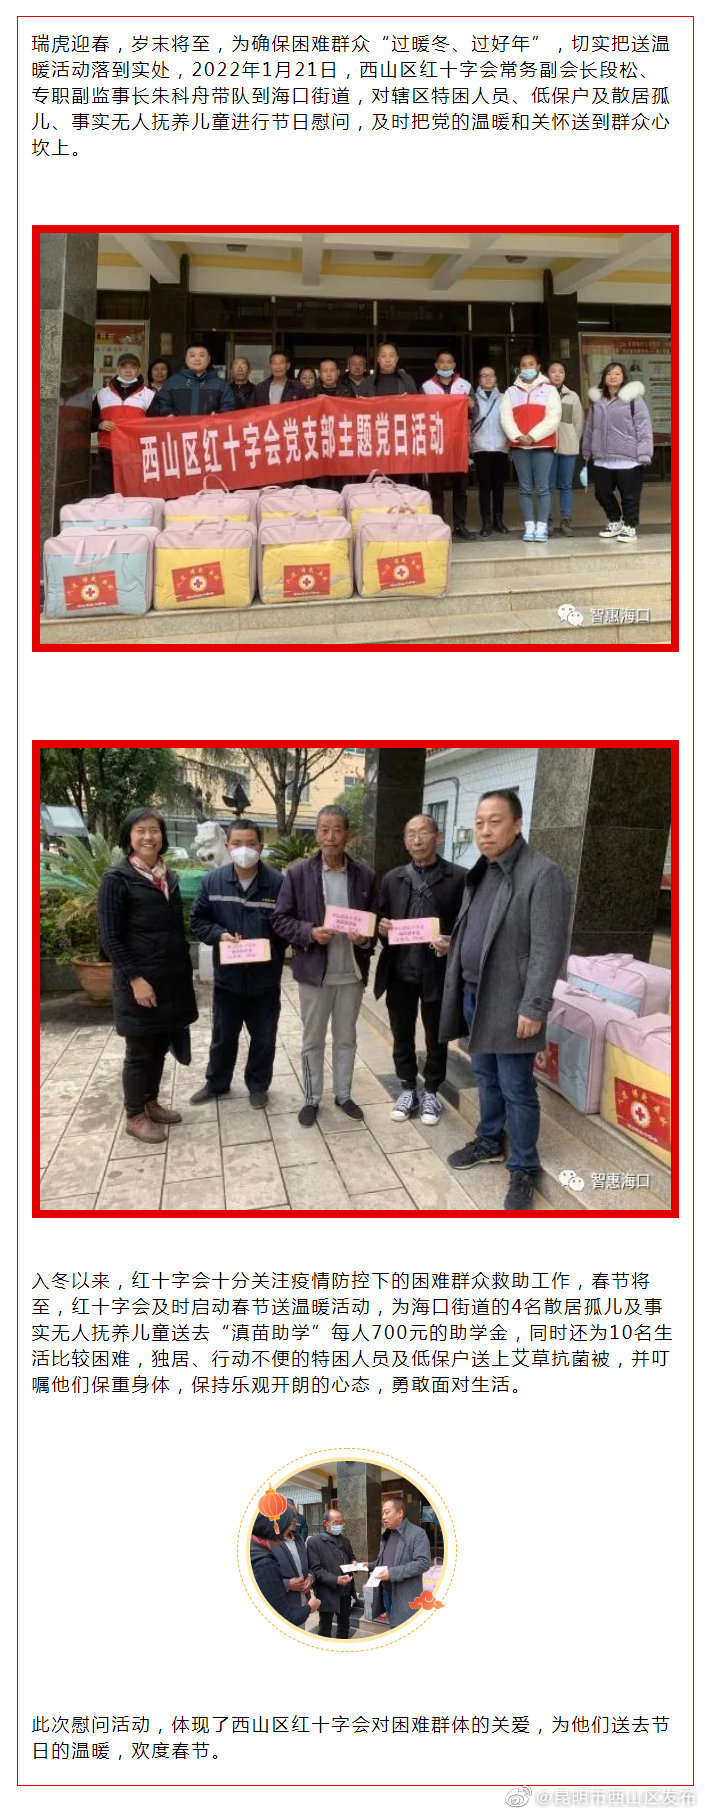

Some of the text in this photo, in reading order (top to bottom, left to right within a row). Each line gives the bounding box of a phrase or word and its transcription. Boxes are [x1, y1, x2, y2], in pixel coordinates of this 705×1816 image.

[32, 60, 645, 79] 暖活动落到实处，2022年1月21日，西山区红十字会常务副会长段松、
[32, 86, 669, 105] 专职副监事长朱科舟带队到海口街道，对辖区特困人员、低保户及散居孤
[32, 112, 669, 131] 儿、事实无人抚养儿童进行节日慰问，及时把党的温暖和关怀送到群众心
[32, 139, 77, 156] 坎上。
[139, 411, 444, 483] 西山区红十字会党支部主题党日活动
[32, 1271, 649, 1290] 入冬以来，红十字会十分关注疫情防控下的困难群众救助工作，春节将
[32, 1297, 662, 1316] 至，红十字会及时启动春节送温暖活动，为海口街道的4名散居孤儿及事
[32, 1348, 669, 1368] 活比较困难，独居、行动不便的特困人员及低保户送上艾草抗菌被，并叮
[32, 1375, 517, 1394] 嘱他们保重身体，保持乐观开朗的心态，勇敢面对生活。
[32, 1715, 669, 1734] 此次慰问活动，体现了西山区红十字会对困难群体的关爱，为他们送去节
[32, 1742, 219, 1760] 日的温暖，欢度春节。
